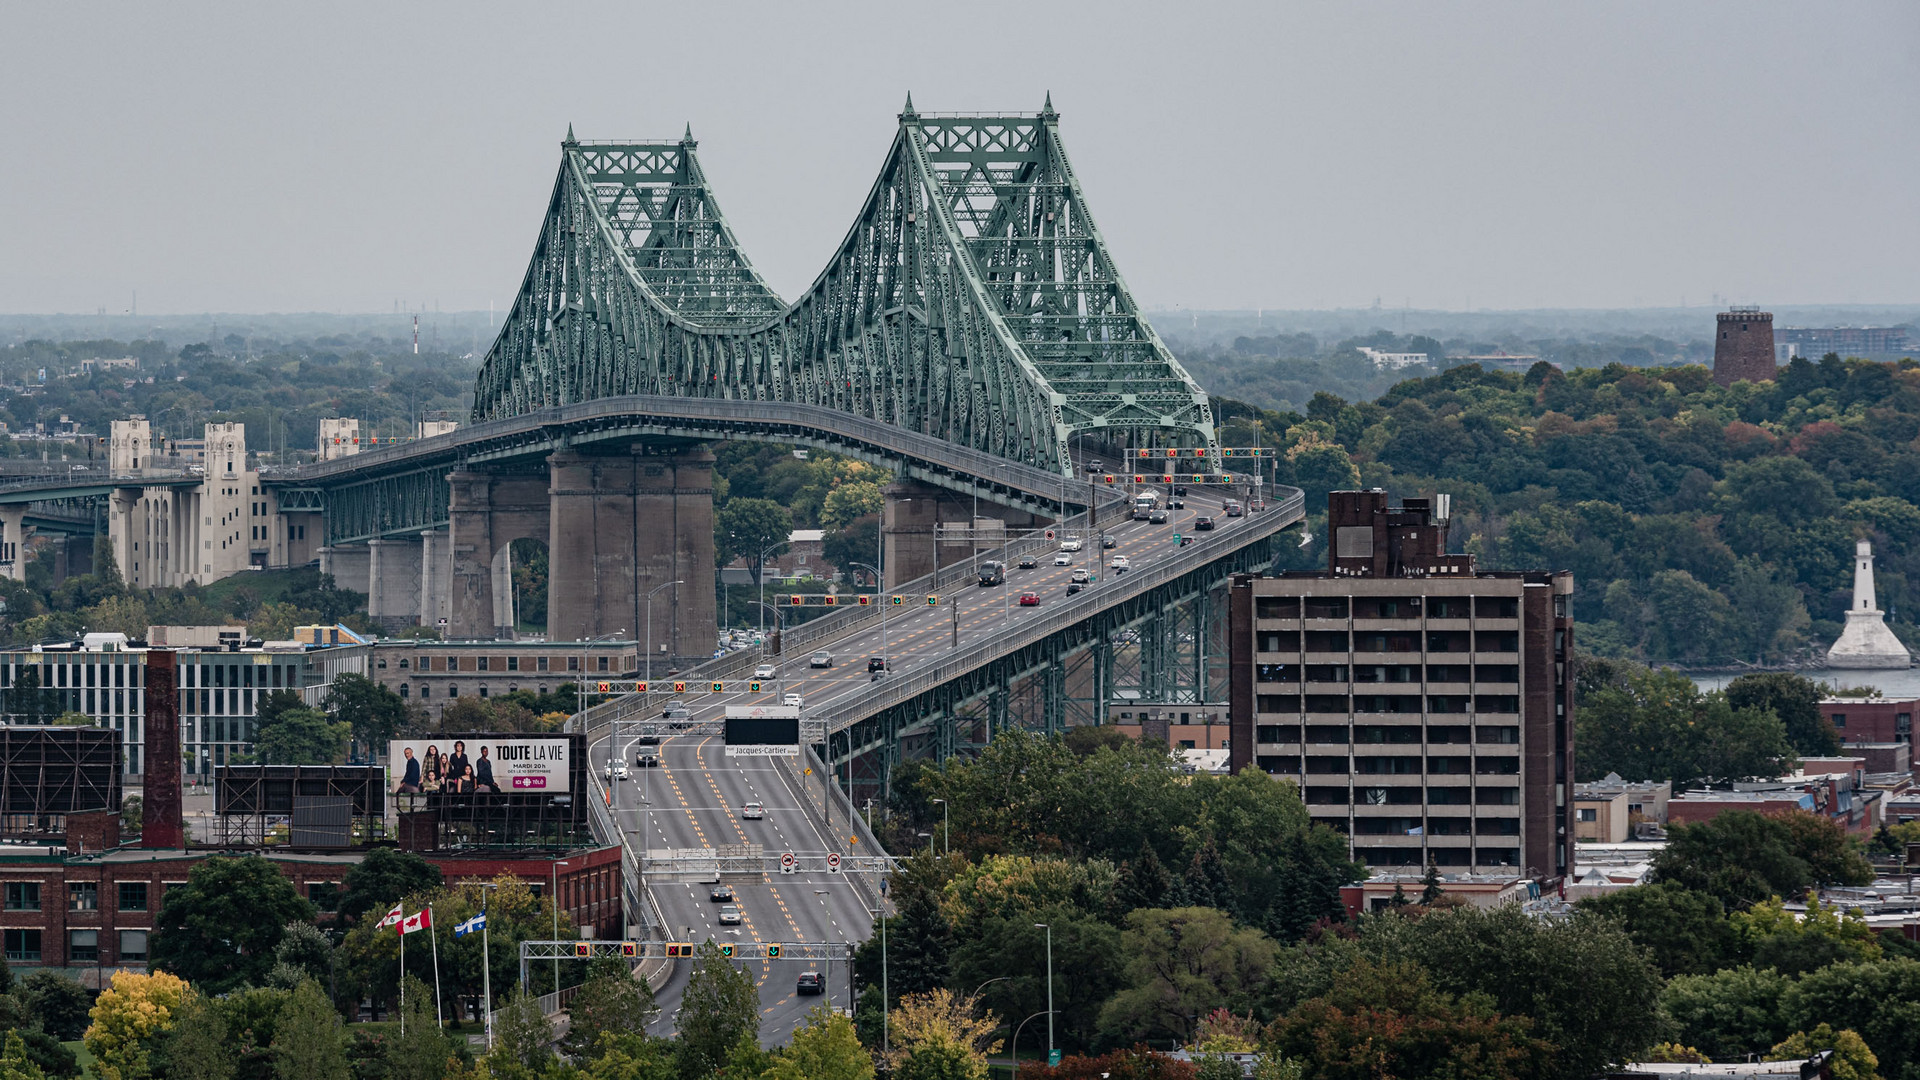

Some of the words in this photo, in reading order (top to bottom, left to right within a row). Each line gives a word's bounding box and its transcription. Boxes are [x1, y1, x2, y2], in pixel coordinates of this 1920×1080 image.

[496, 745, 530, 760] TOUTE
[534, 745, 546, 760] LA
[548, 745, 563, 760] VIE
[736, 746, 786, 755] Jacques-Cartier
